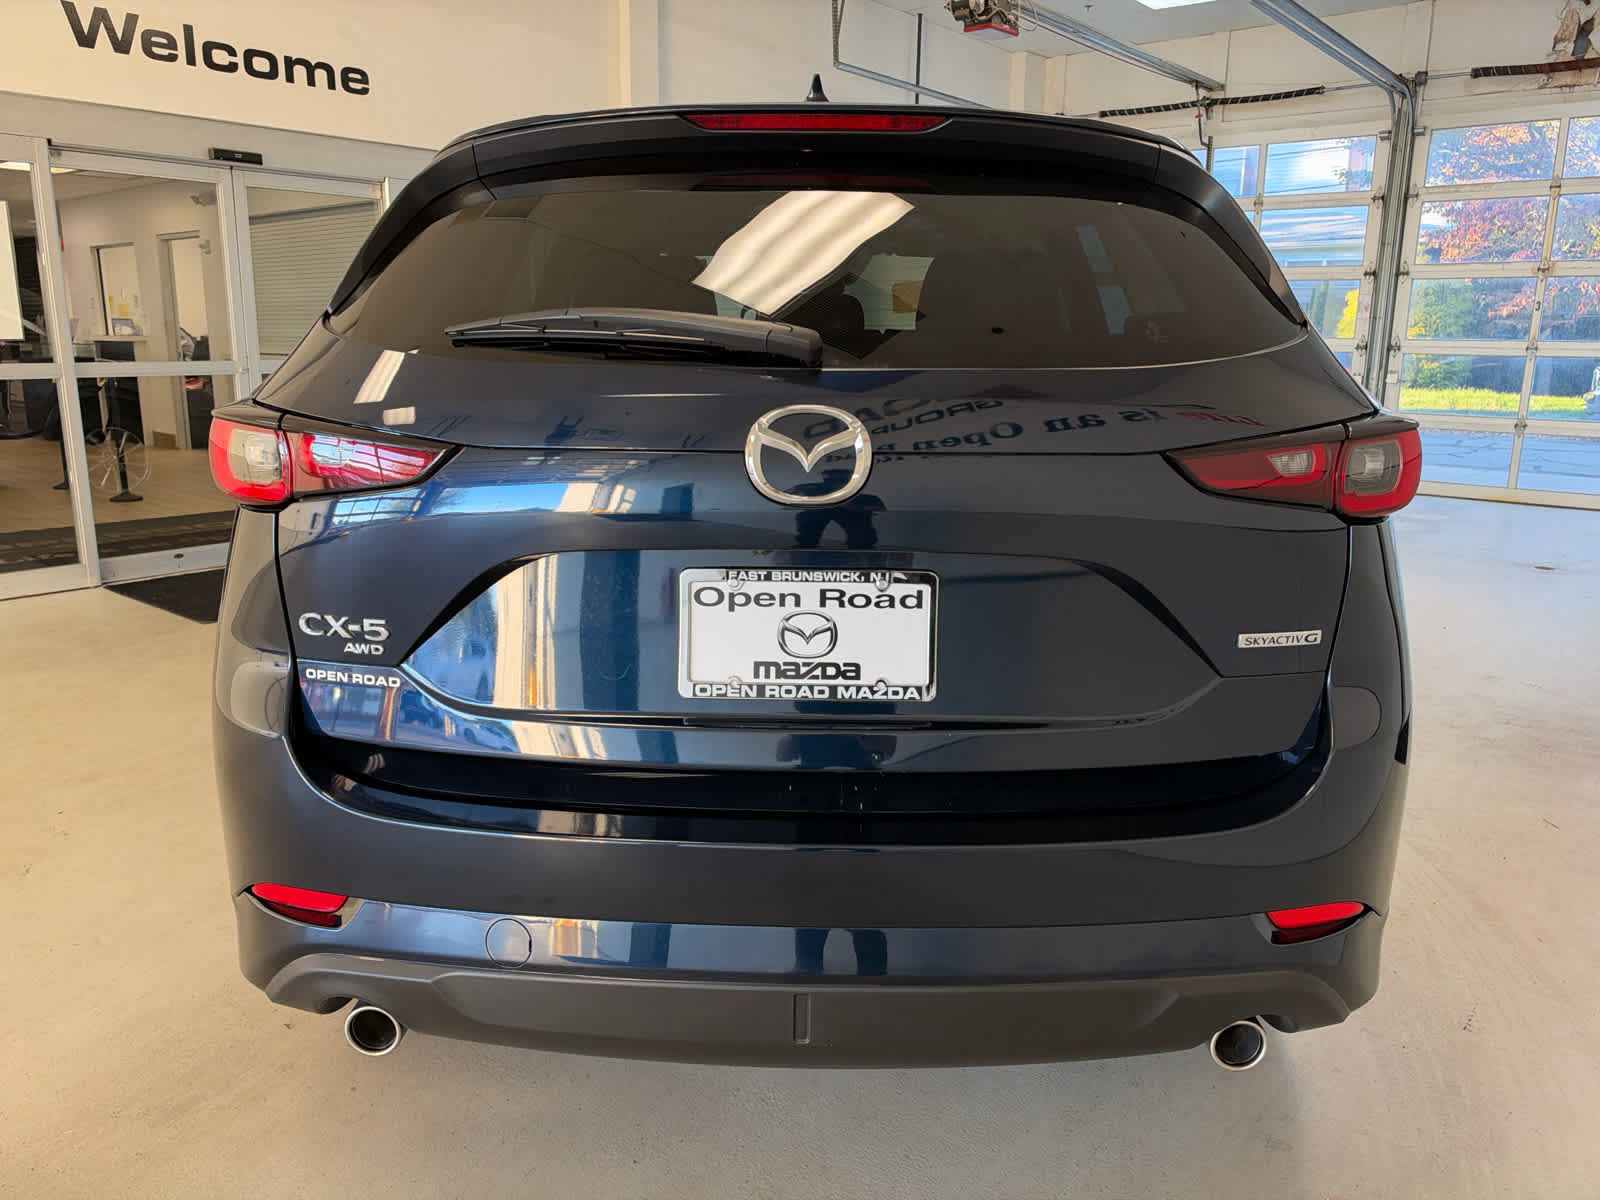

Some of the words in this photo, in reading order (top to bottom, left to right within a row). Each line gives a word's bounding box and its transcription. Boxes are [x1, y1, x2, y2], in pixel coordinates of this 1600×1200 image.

[60, 0, 370, 96] Welcome
[1535, 301, 1541, 311] 3
[771, 571, 865, 582] BRUNSWICK,
[693, 586, 801, 612] Open
[819, 588, 923, 609] Road
[298, 612, 390, 641] CX-5
[343, 642, 384, 655] AWD
[305, 668, 348, 682] OPEN
[352, 673, 401, 688] ROAD
[694, 684, 757, 698] OPEN
[764, 684, 830, 699] ROAD
